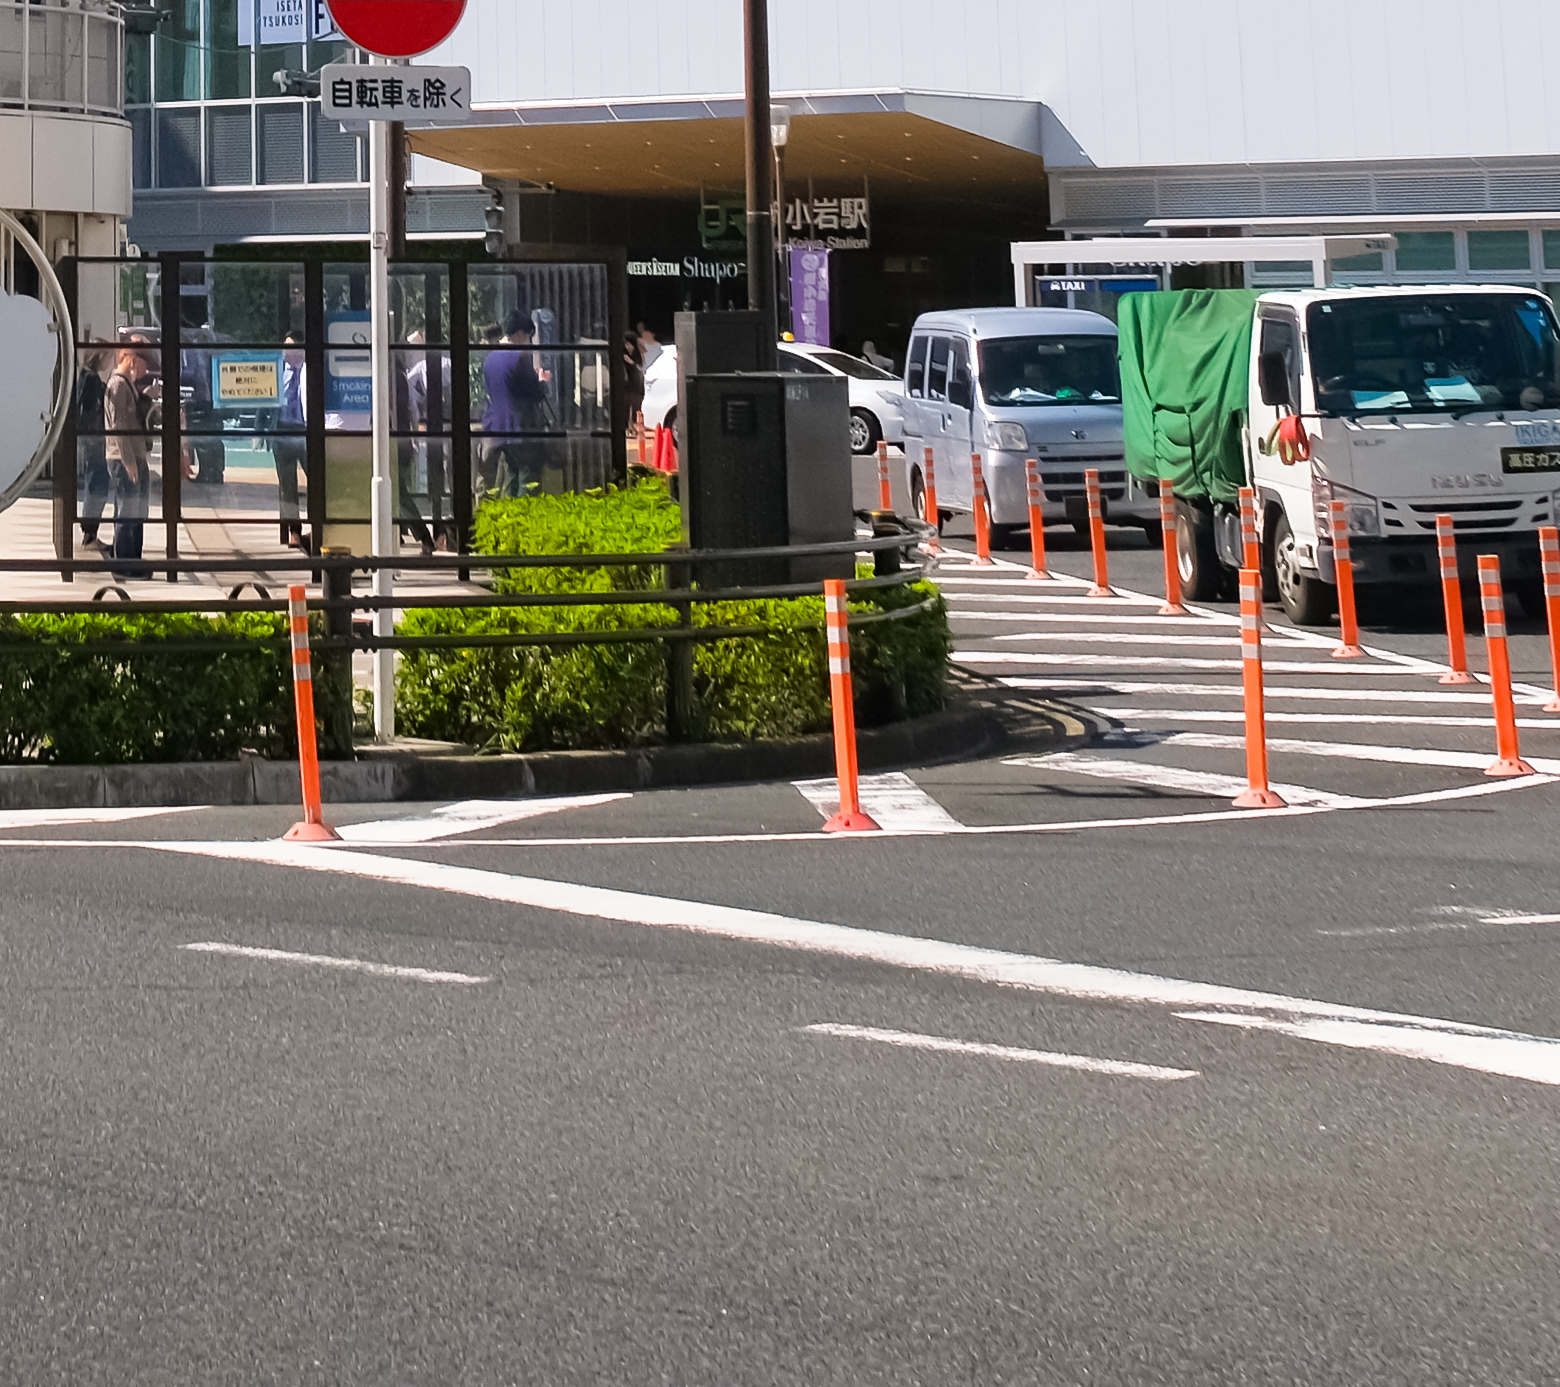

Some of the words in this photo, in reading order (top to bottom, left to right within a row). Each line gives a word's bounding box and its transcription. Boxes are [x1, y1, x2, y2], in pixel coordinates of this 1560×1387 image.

[276, 0, 304, 13] ISETA
[331, 76, 463, 110] 自転車を除く
[682, 255, 747, 285] Shapo
[332, 380, 372, 392] Smokin
[342, 393, 370, 404] Area
